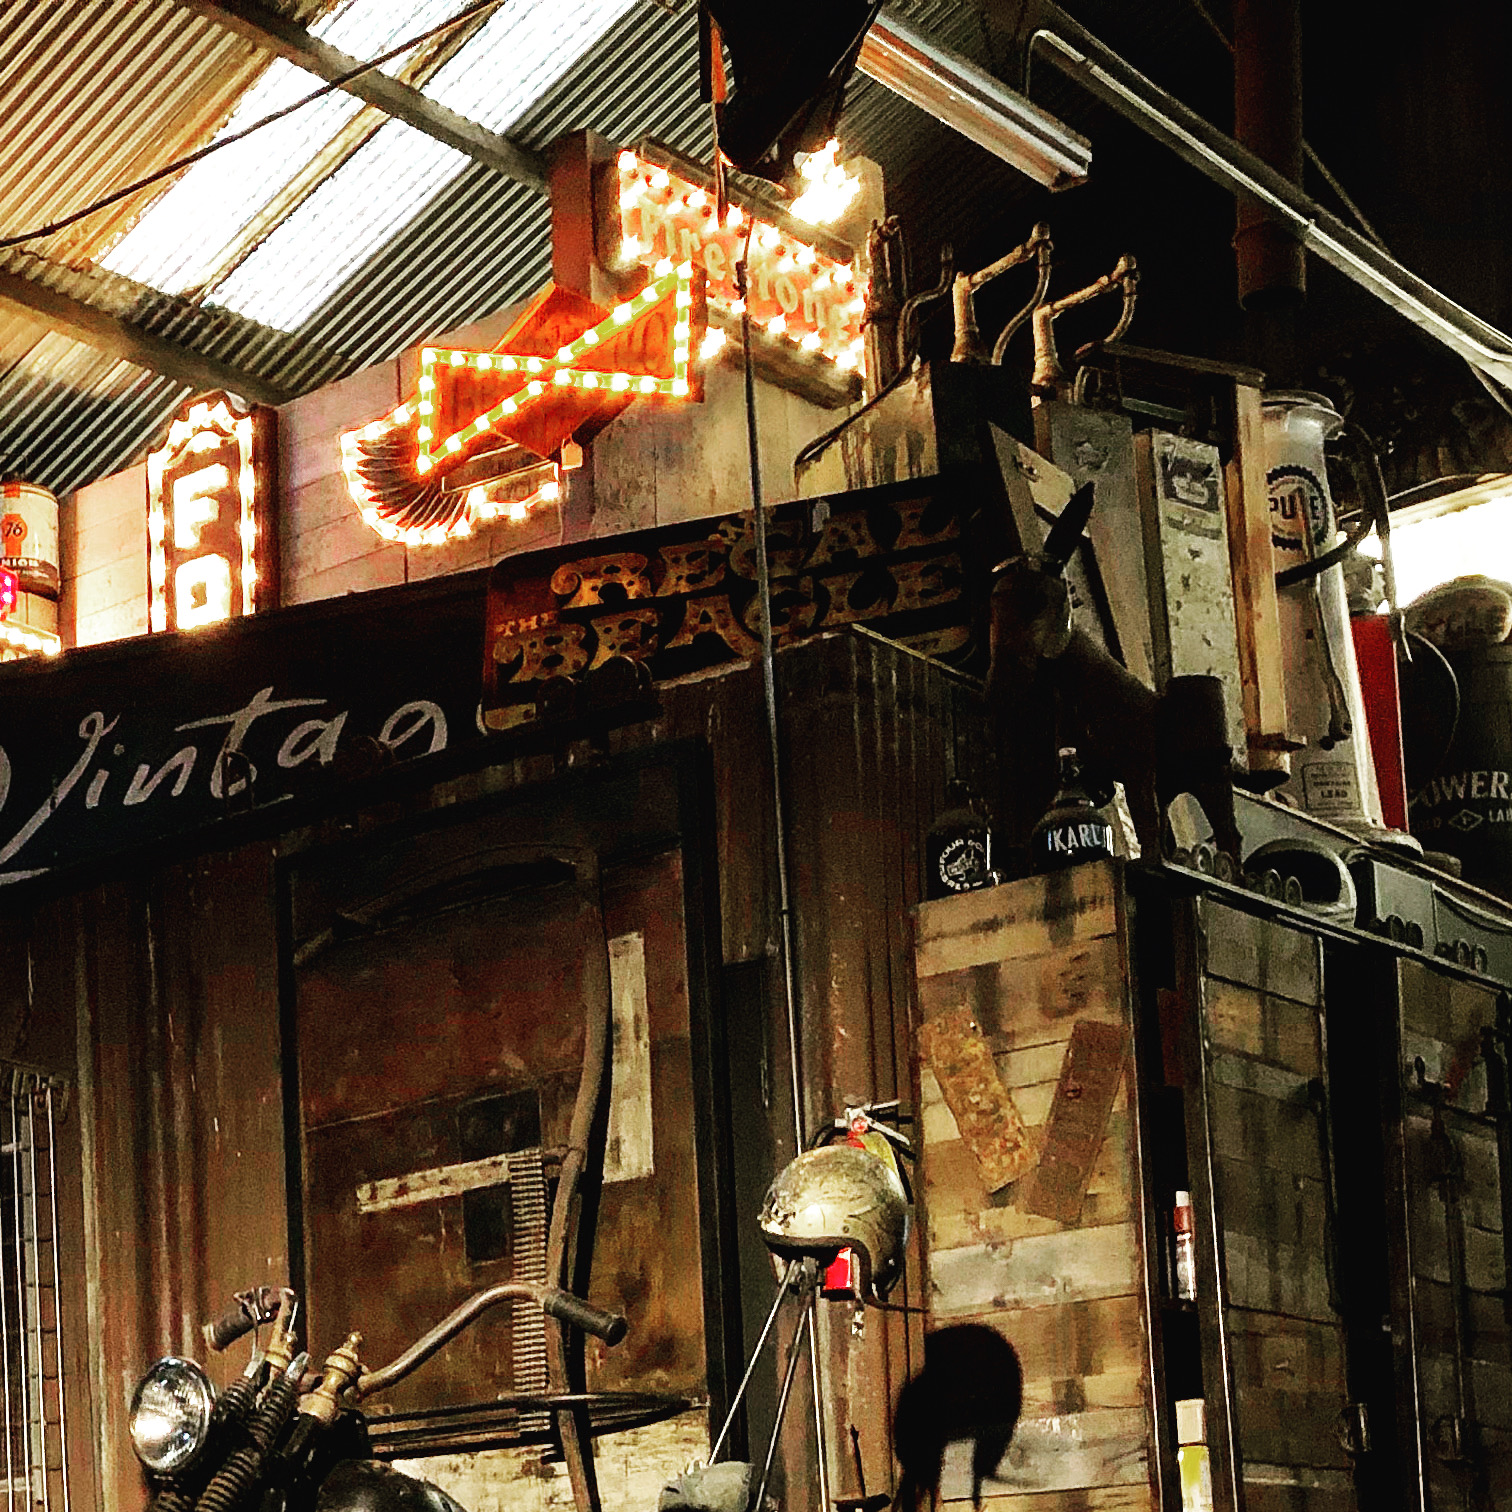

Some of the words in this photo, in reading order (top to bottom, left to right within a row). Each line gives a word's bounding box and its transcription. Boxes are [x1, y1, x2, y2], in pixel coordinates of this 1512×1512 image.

[5, 522, 23, 537] 76
[1268, 495, 1319, 519] PUE
[550, 496, 960, 610] REGAL
[493, 552, 963, 686] BEAGLE
